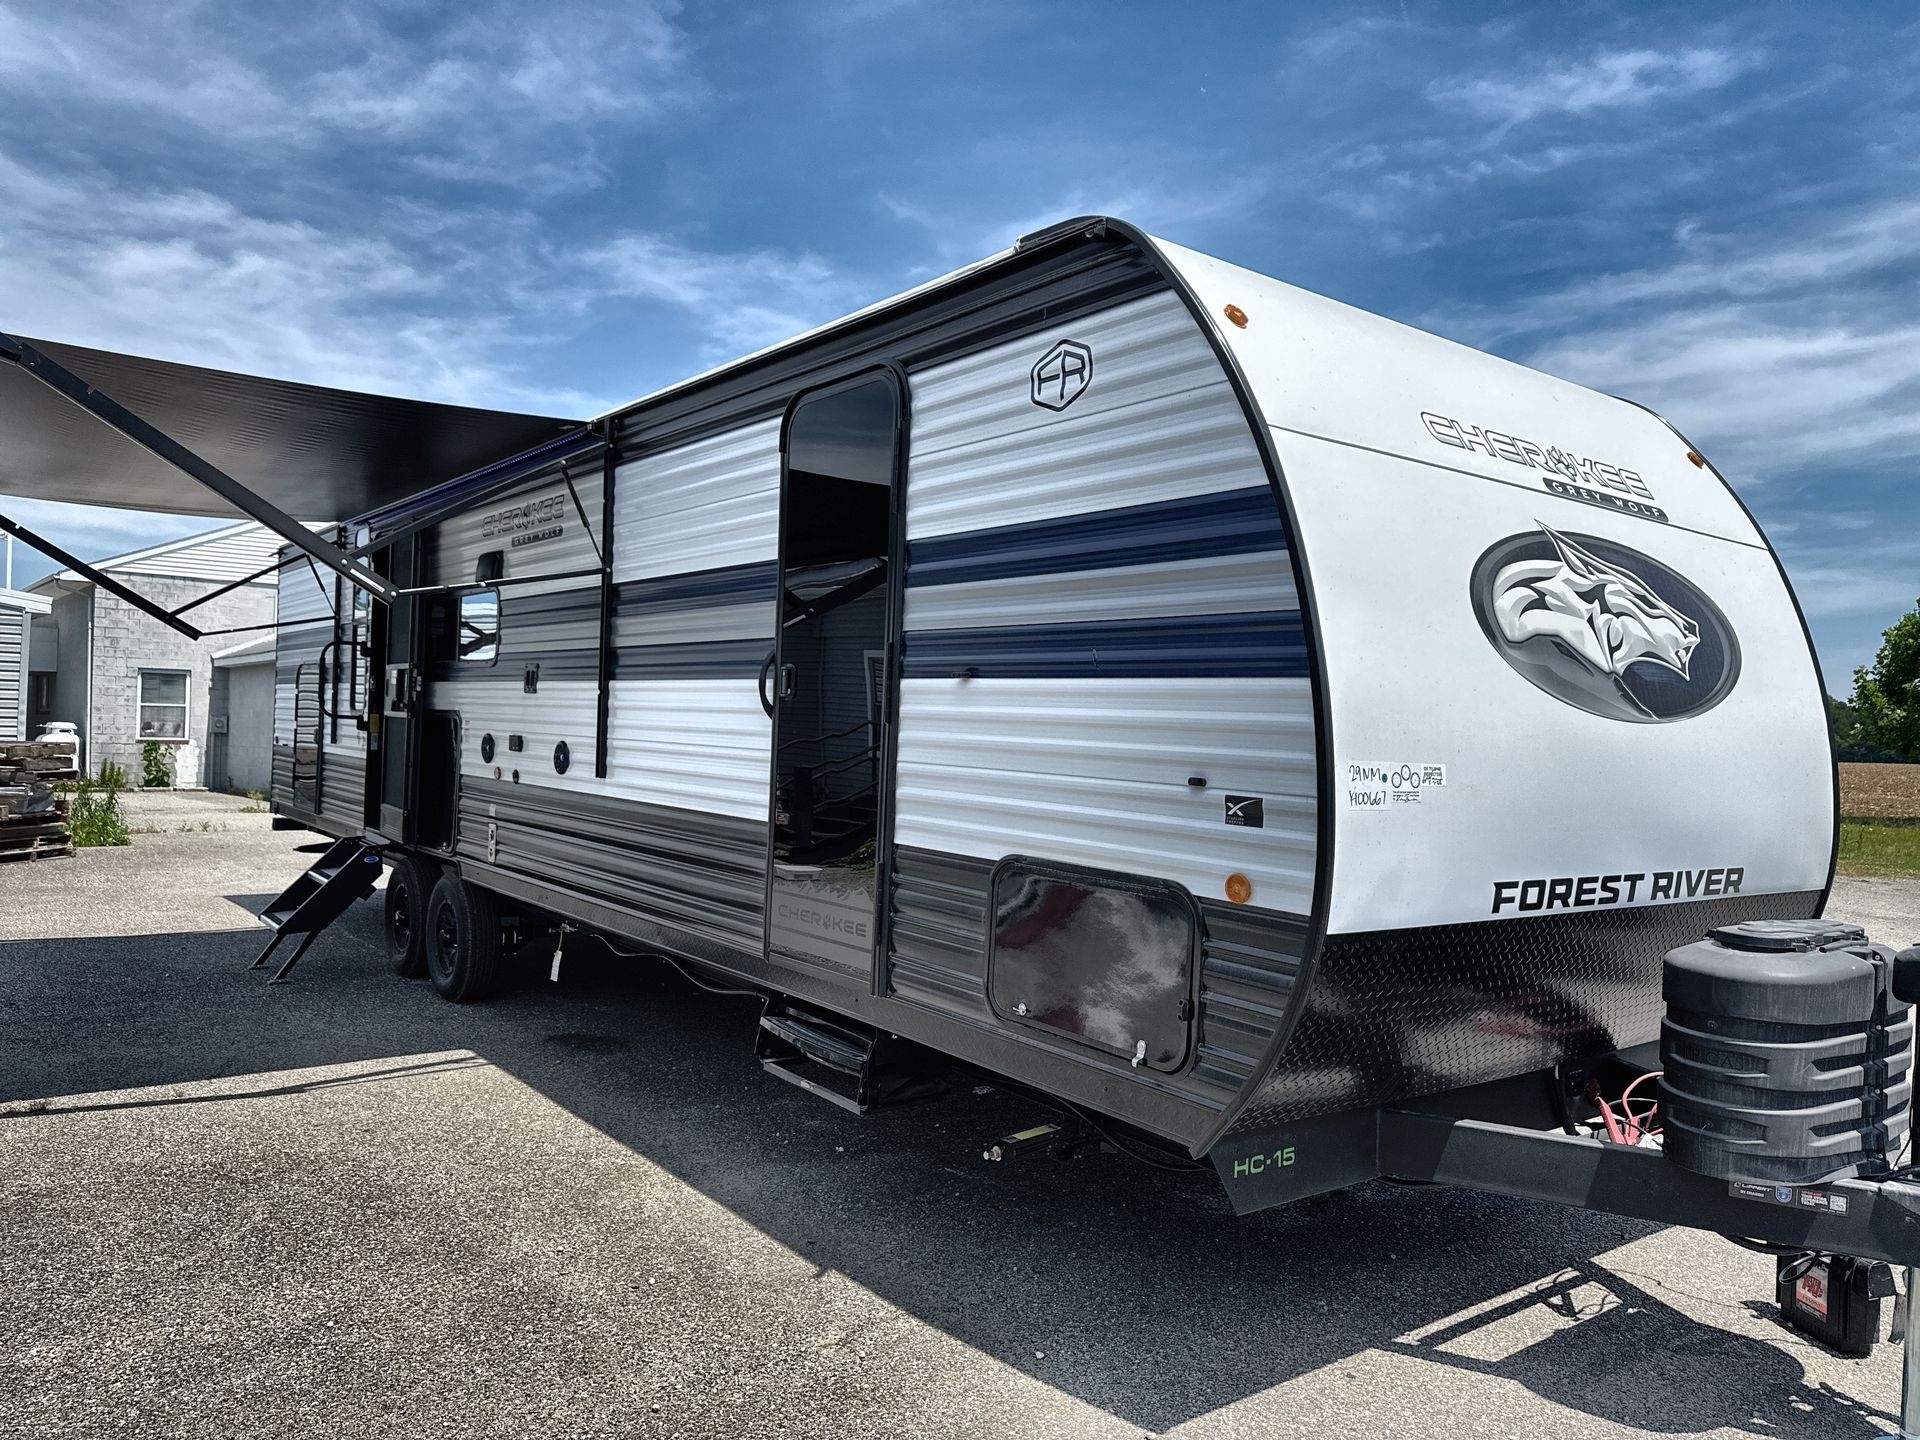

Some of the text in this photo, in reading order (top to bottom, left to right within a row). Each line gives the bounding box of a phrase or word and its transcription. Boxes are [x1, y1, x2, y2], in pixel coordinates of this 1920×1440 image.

[1551, 481, 1661, 518] GREY WOLF
[1491, 867, 1745, 914] FOREST RIVER
[1233, 1146, 1296, 1179] HC-15
